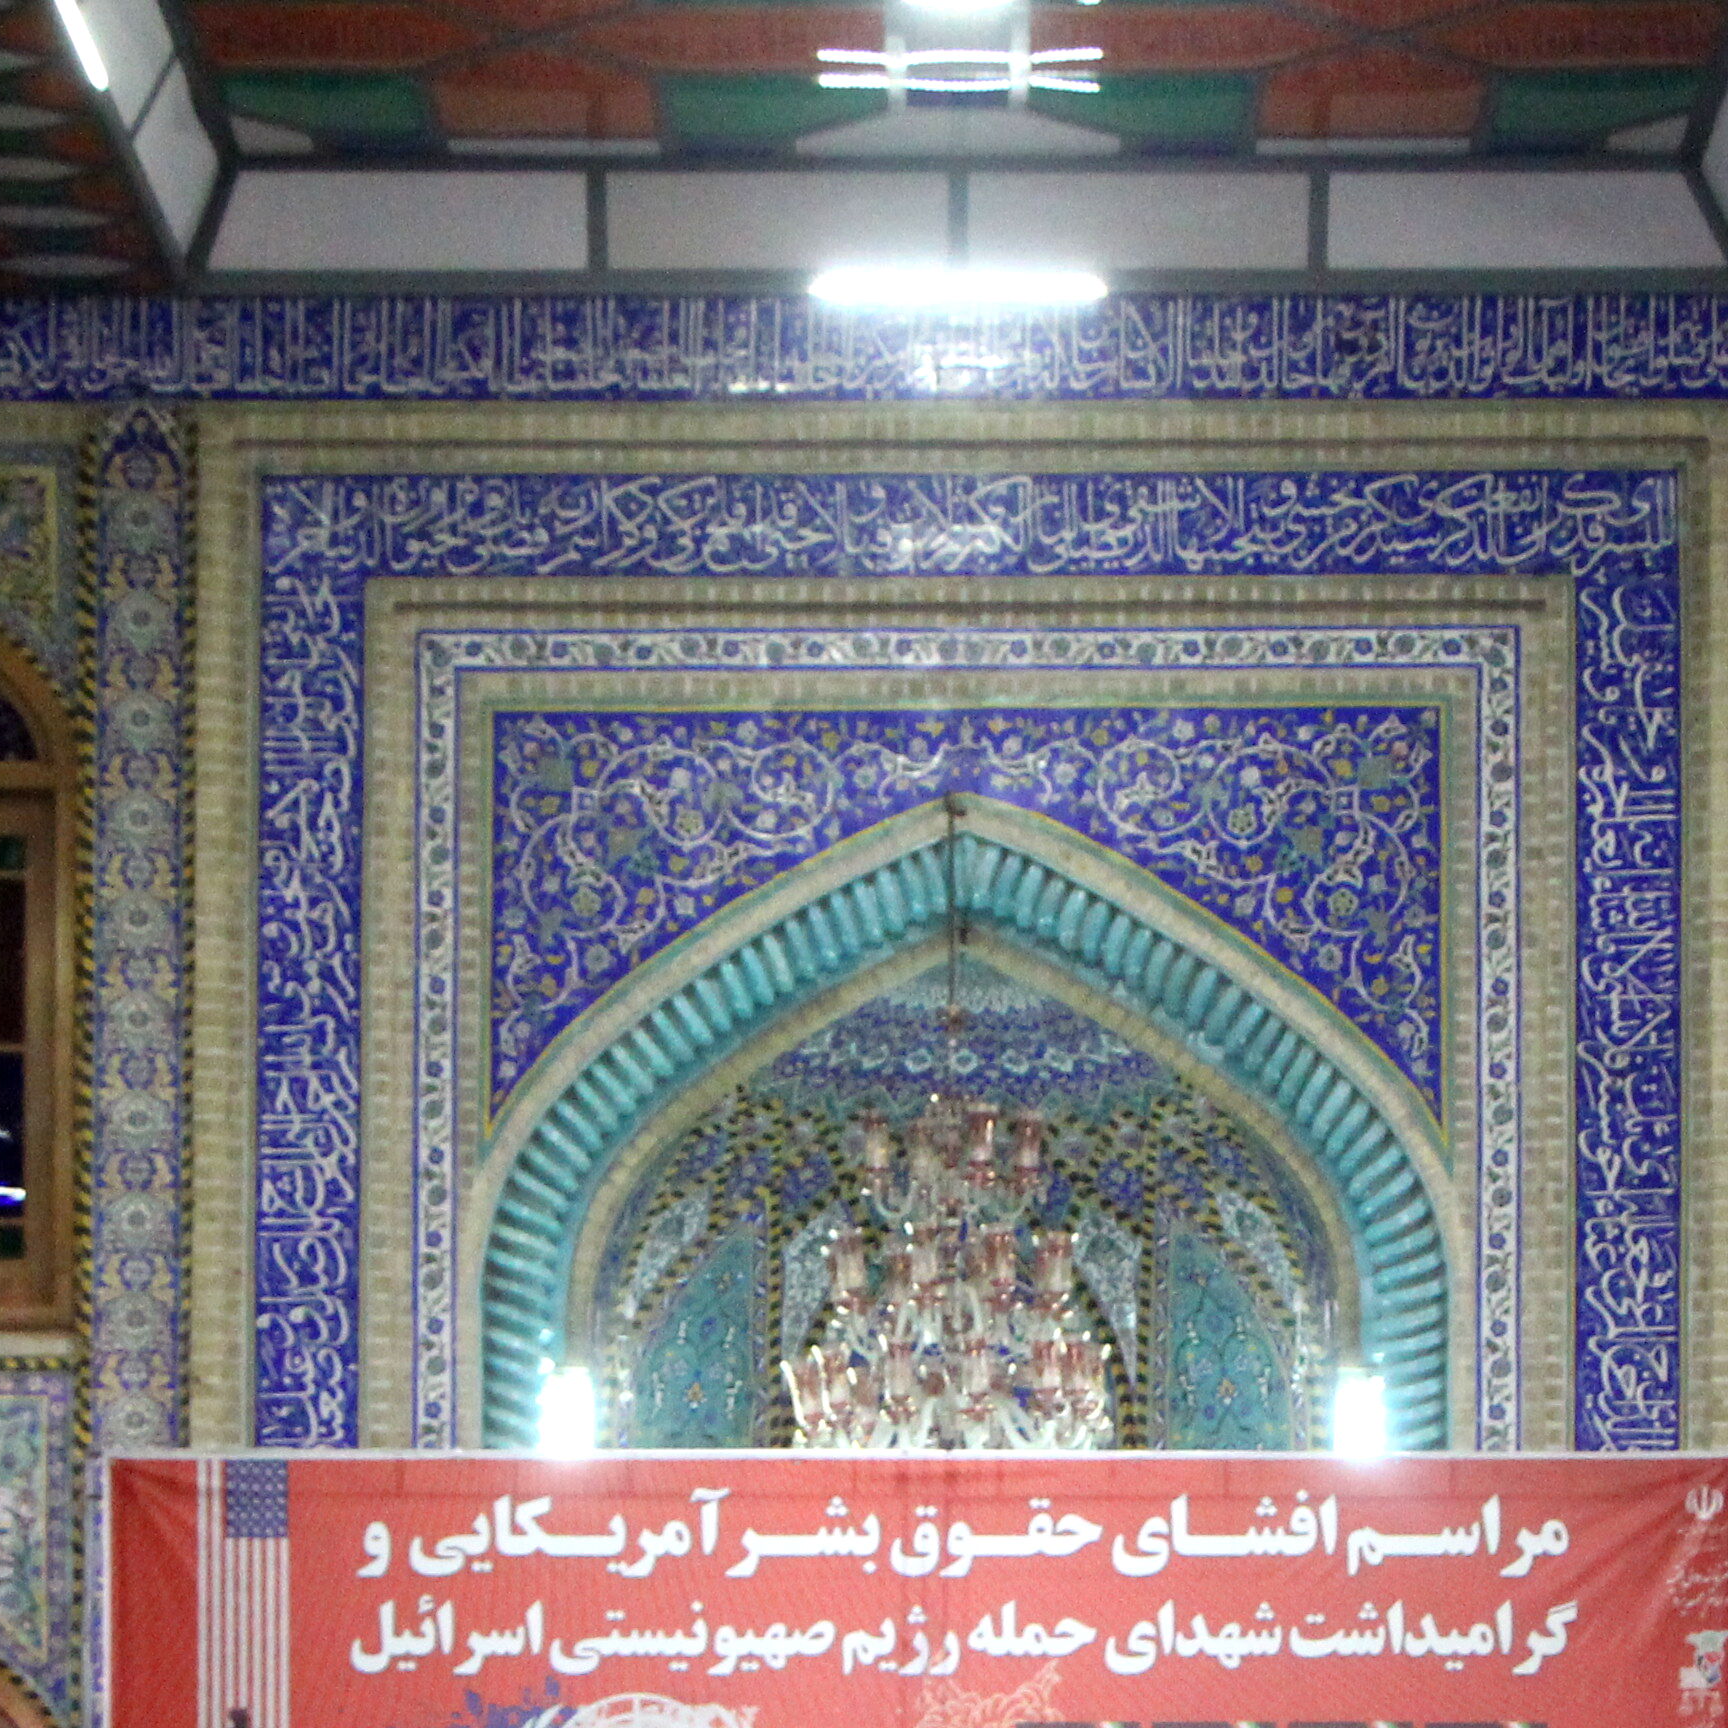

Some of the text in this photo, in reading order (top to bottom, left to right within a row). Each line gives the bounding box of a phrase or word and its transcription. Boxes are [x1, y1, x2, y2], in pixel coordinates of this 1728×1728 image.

[356, 1486, 1570, 1578] مراسم افشای حقوق بشر آمریکایی و
[348, 1593, 1580, 1676] گرامیداشت شهدای حمله رژیم صهیونیستی اسرائیل
